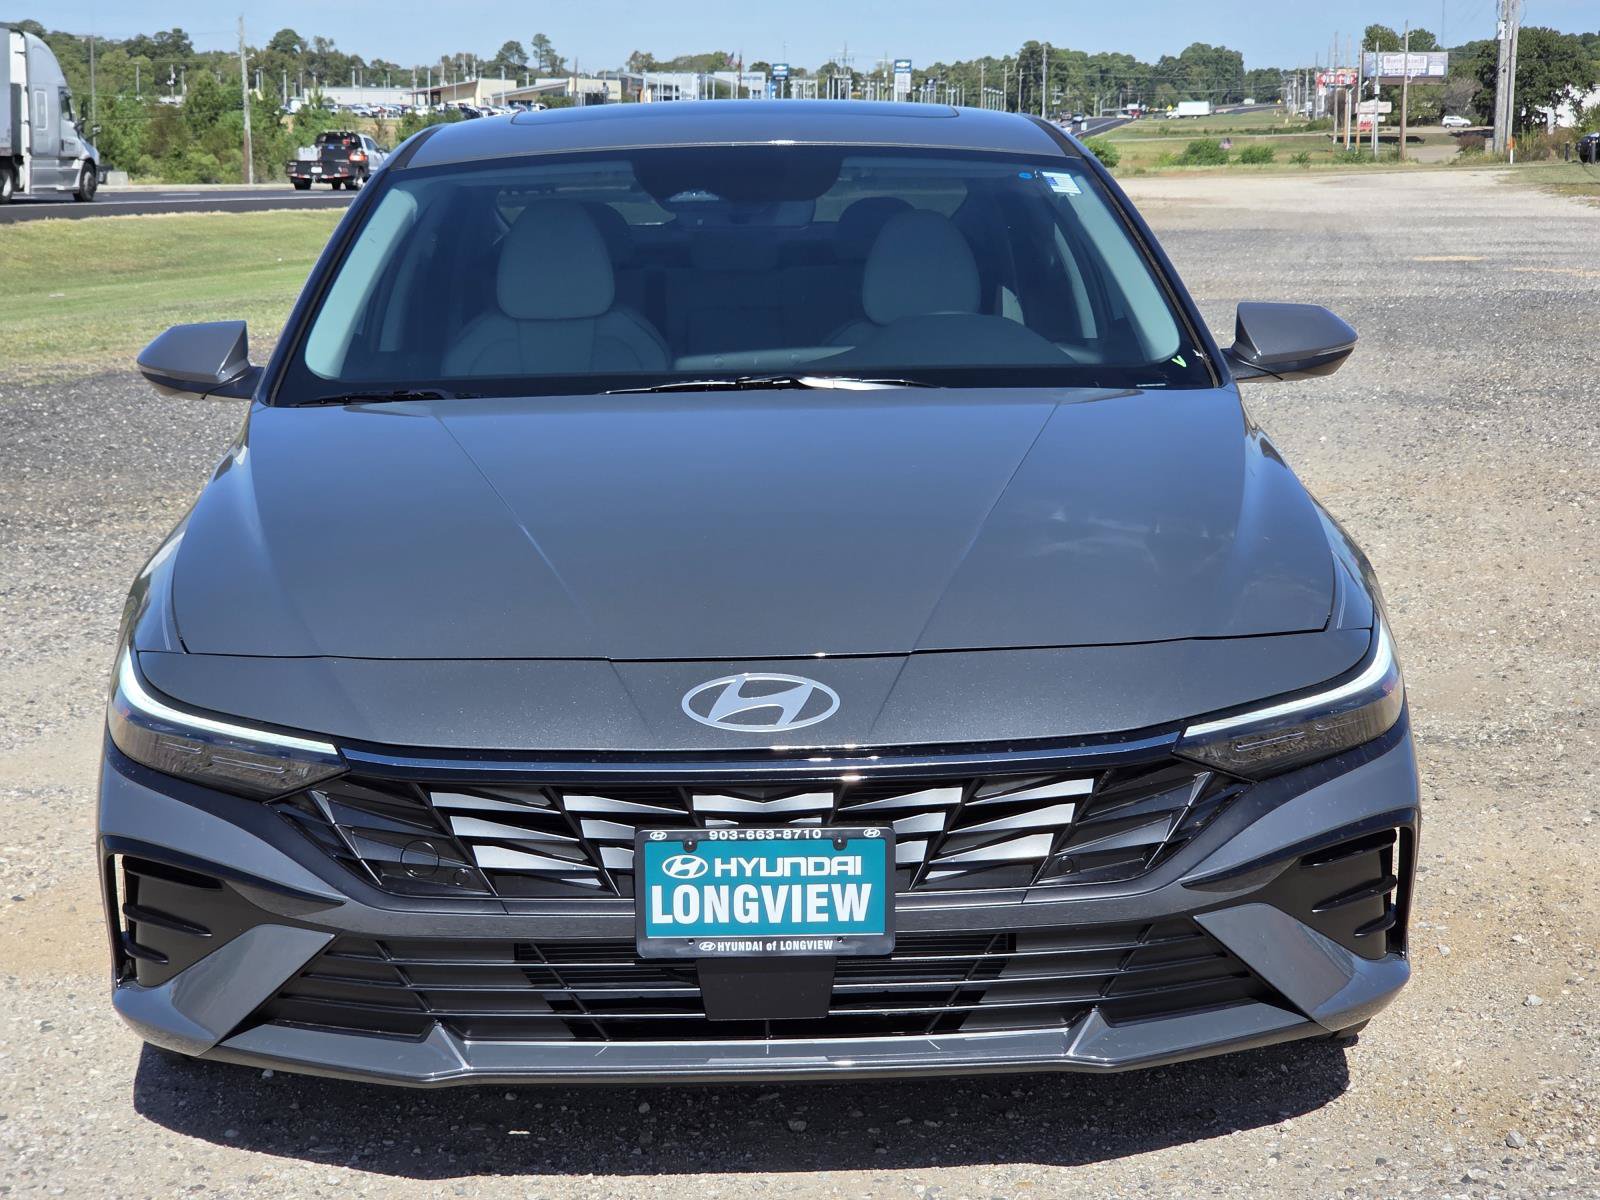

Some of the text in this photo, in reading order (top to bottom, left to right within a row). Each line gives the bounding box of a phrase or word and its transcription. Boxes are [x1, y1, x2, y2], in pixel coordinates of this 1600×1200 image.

[709, 830, 822, 841] 903-663-8710
[714, 855, 862, 877] HYUNDAI
[651, 883, 872, 924] LONGVIEW
[717, 940, 833, 951] HYUNDAI of LONGVIEW
